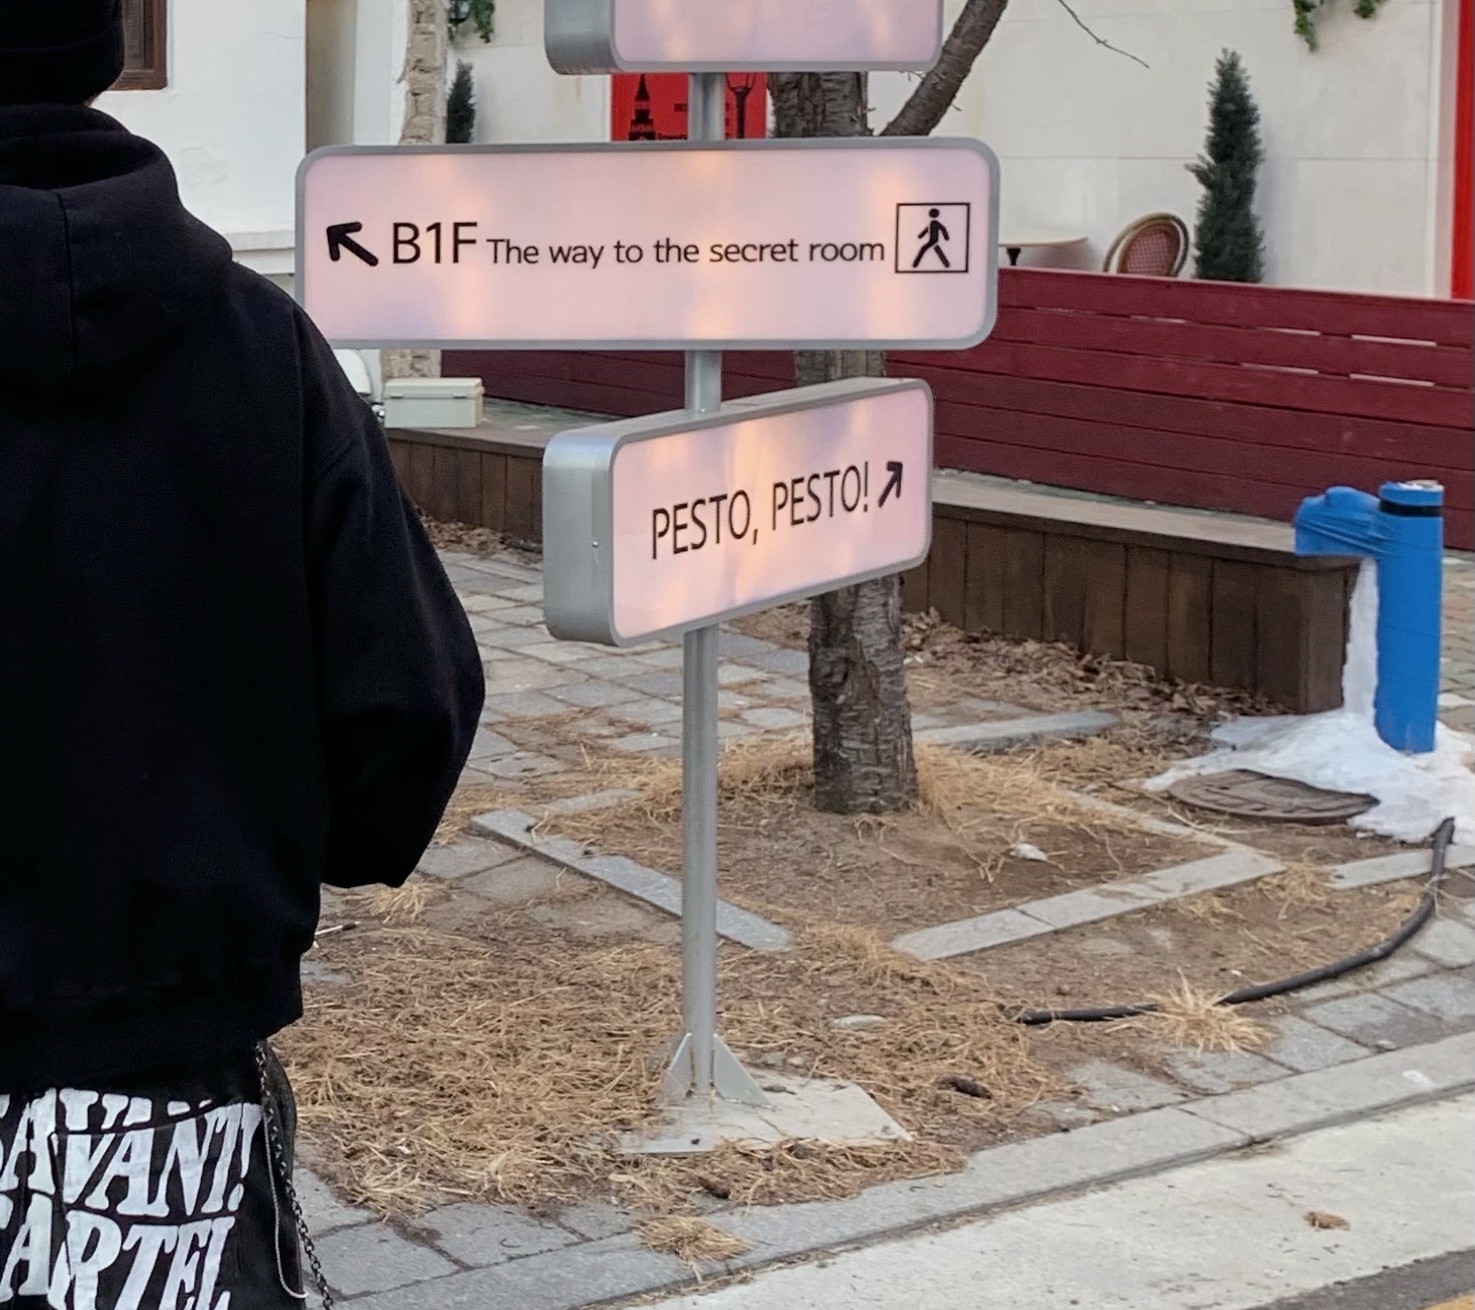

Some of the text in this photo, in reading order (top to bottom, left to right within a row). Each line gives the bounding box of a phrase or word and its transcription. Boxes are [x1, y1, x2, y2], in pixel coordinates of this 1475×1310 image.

[391, 221, 886, 270] B1F The way to the secret room
[651, 461, 870, 561] PESTO, PESTO!
